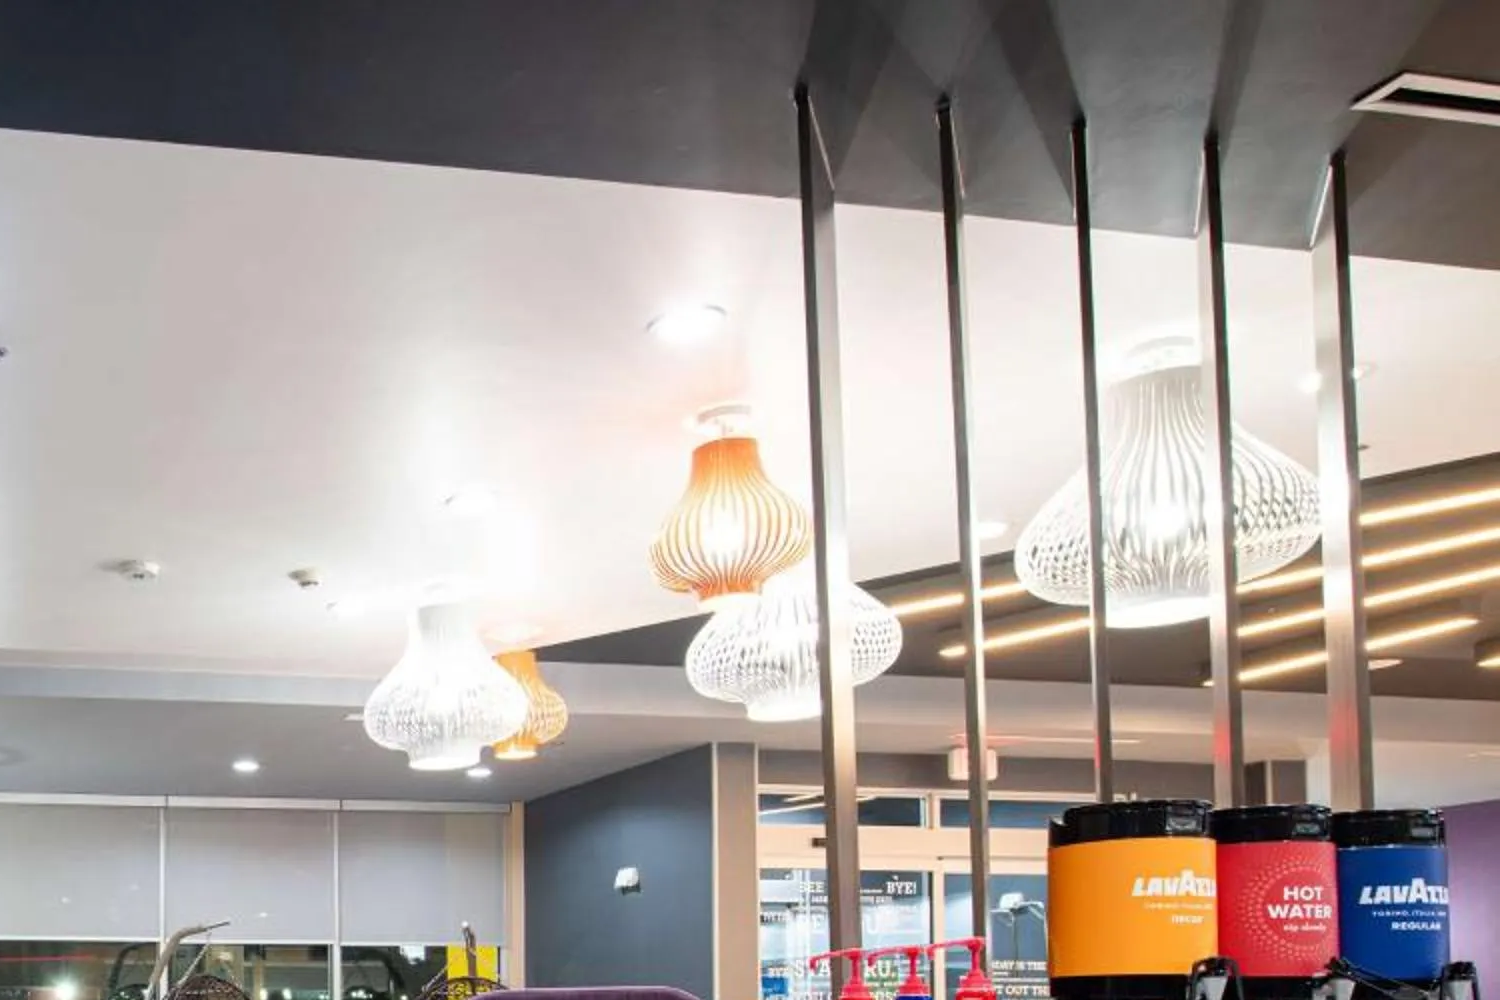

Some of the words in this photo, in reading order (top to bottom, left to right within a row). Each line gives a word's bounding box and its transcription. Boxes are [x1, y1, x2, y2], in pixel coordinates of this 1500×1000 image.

[885, 881, 917, 896] BYE!
[1283, 885, 1324, 901] HOT
[1267, 904, 1333, 920] WATER
[1391, 921, 1442, 931] REGULAR
